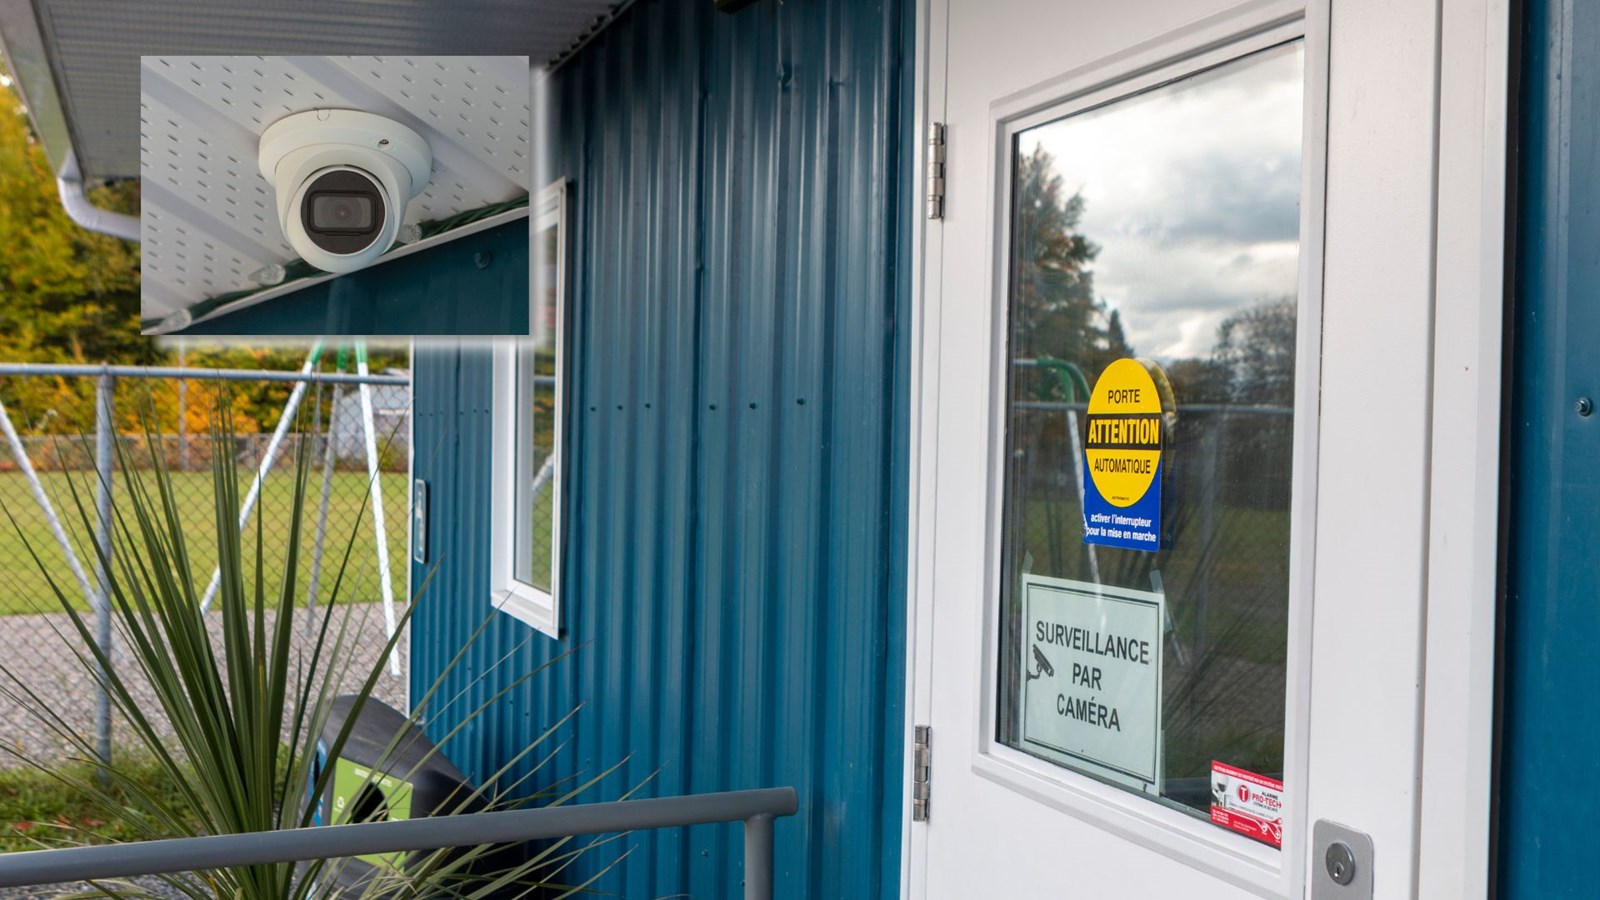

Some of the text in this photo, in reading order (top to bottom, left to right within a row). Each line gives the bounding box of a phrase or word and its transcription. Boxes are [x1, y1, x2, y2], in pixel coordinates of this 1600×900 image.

[1108, 389, 1140, 404] PORTE
[1088, 419, 1159, 444] ATTENTION
[1094, 458, 1151, 475] AUTOMATIQUE
[1090, 513, 1152, 528] activer l'interrupteur
[1086, 526, 1157, 542] pour la mise en marche
[1036, 620, 1149, 665] SURVEILLANCE
[1072, 662, 1102, 691] PAR
[1056, 693, 1121, 732] CAMÉRA
[1252, 794, 1281, 808] PRO-TECH
